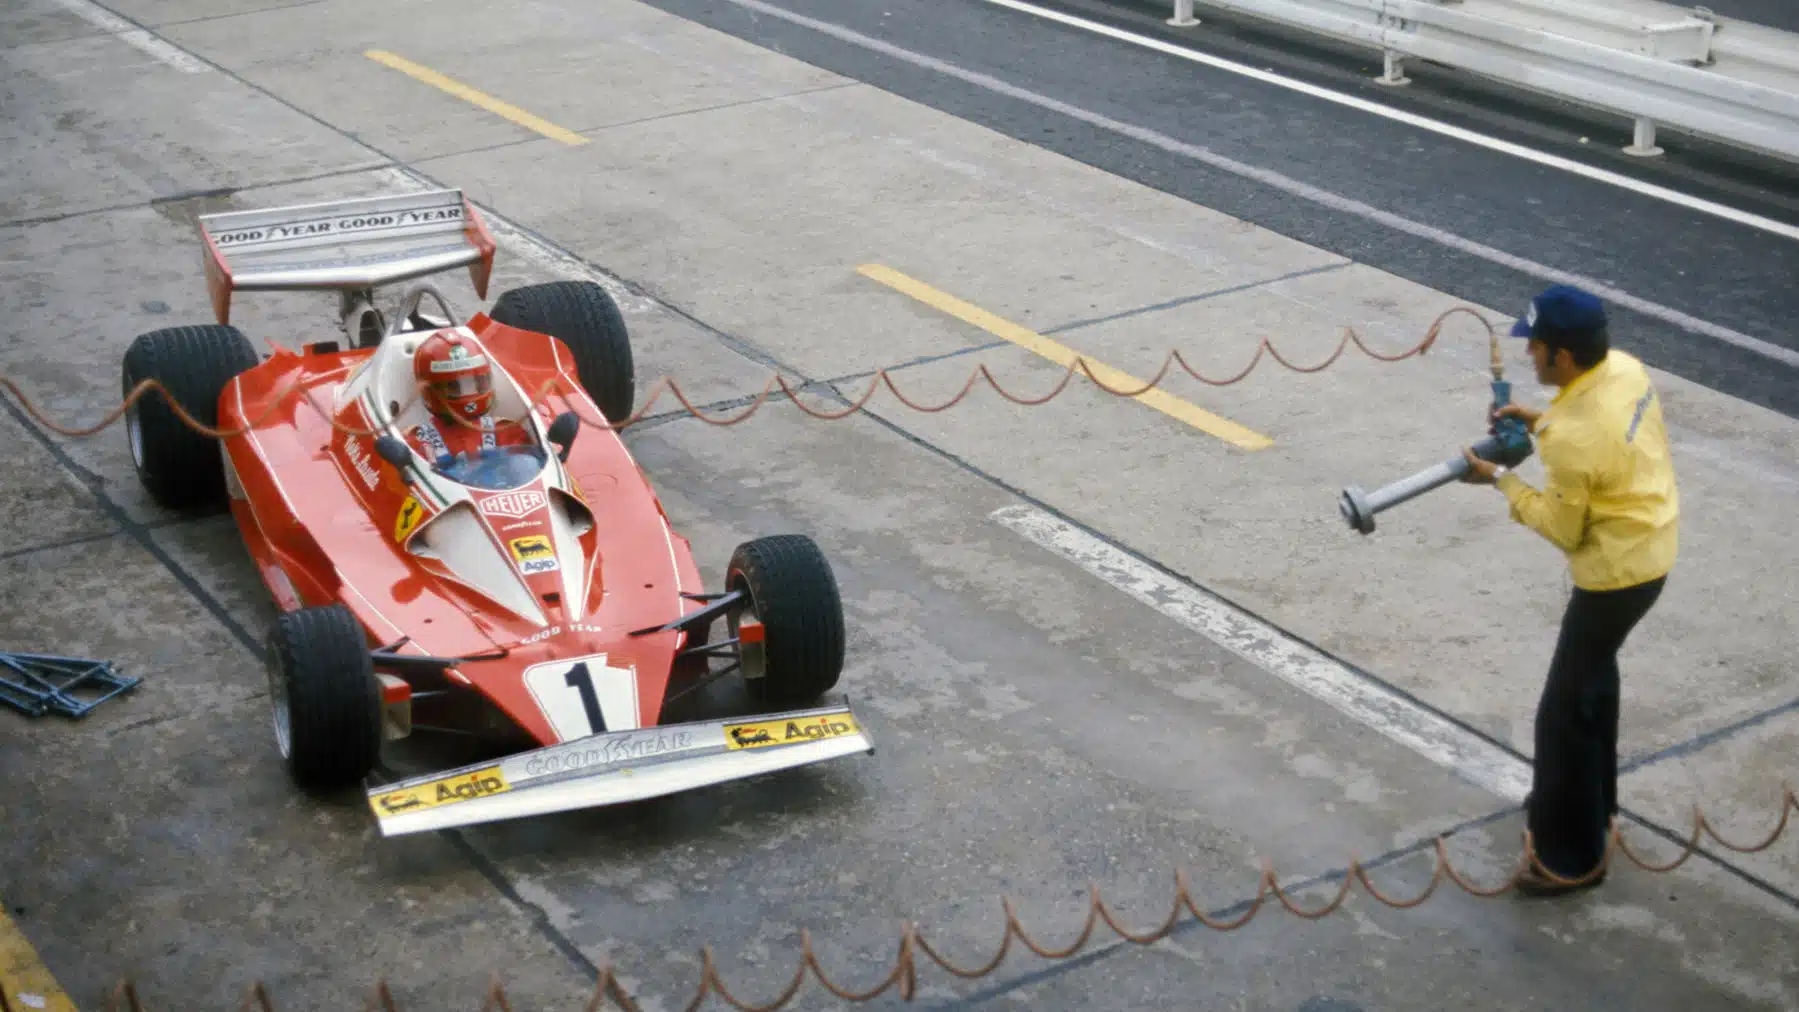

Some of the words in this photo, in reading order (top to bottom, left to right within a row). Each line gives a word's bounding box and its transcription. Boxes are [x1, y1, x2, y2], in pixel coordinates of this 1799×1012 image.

[214, 231, 262, 244] OOD
[281, 222, 331, 237] YEAR
[339, 216, 394, 229] GOOD
[410, 208, 460, 222] YEAR
[485, 492, 541, 514] HEUER
[525, 560, 556, 572] Agip
[564, 661, 608, 735] 1
[785, 717, 849, 741] Agip
[436, 774, 502, 802] Agip
